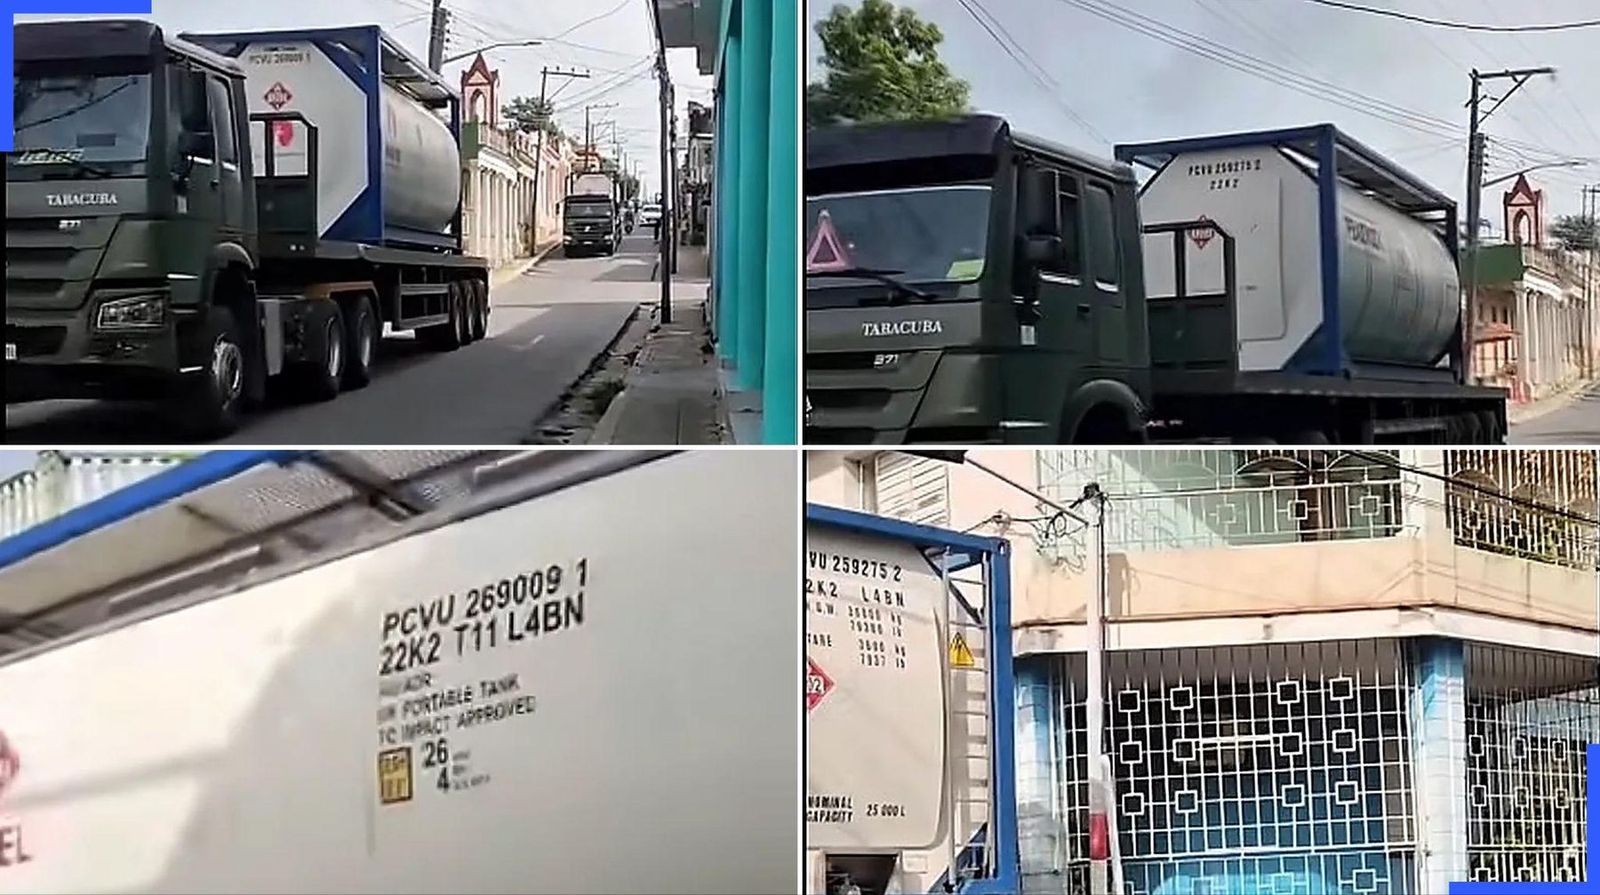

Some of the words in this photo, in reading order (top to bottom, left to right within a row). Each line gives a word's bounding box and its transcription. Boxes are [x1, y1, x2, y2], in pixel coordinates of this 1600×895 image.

[46, 193, 118, 206] TABACUBA
[862, 320, 942, 336] TABACUBA
[833, 555, 888, 579] 259275
[894, 564, 902, 581] 2
[383, 594, 455, 640] PCVU
[466, 565, 562, 619] 269009
[576, 558, 588, 587] 1
[862, 586, 905, 607] L4BN
[379, 632, 441, 676] 22K2
[453, 616, 497, 656] T11
[507, 591, 584, 641] L4BN
[423, 738, 449, 768] 26
[436, 767, 451, 792] 4
[867, 803, 879, 817] 25
